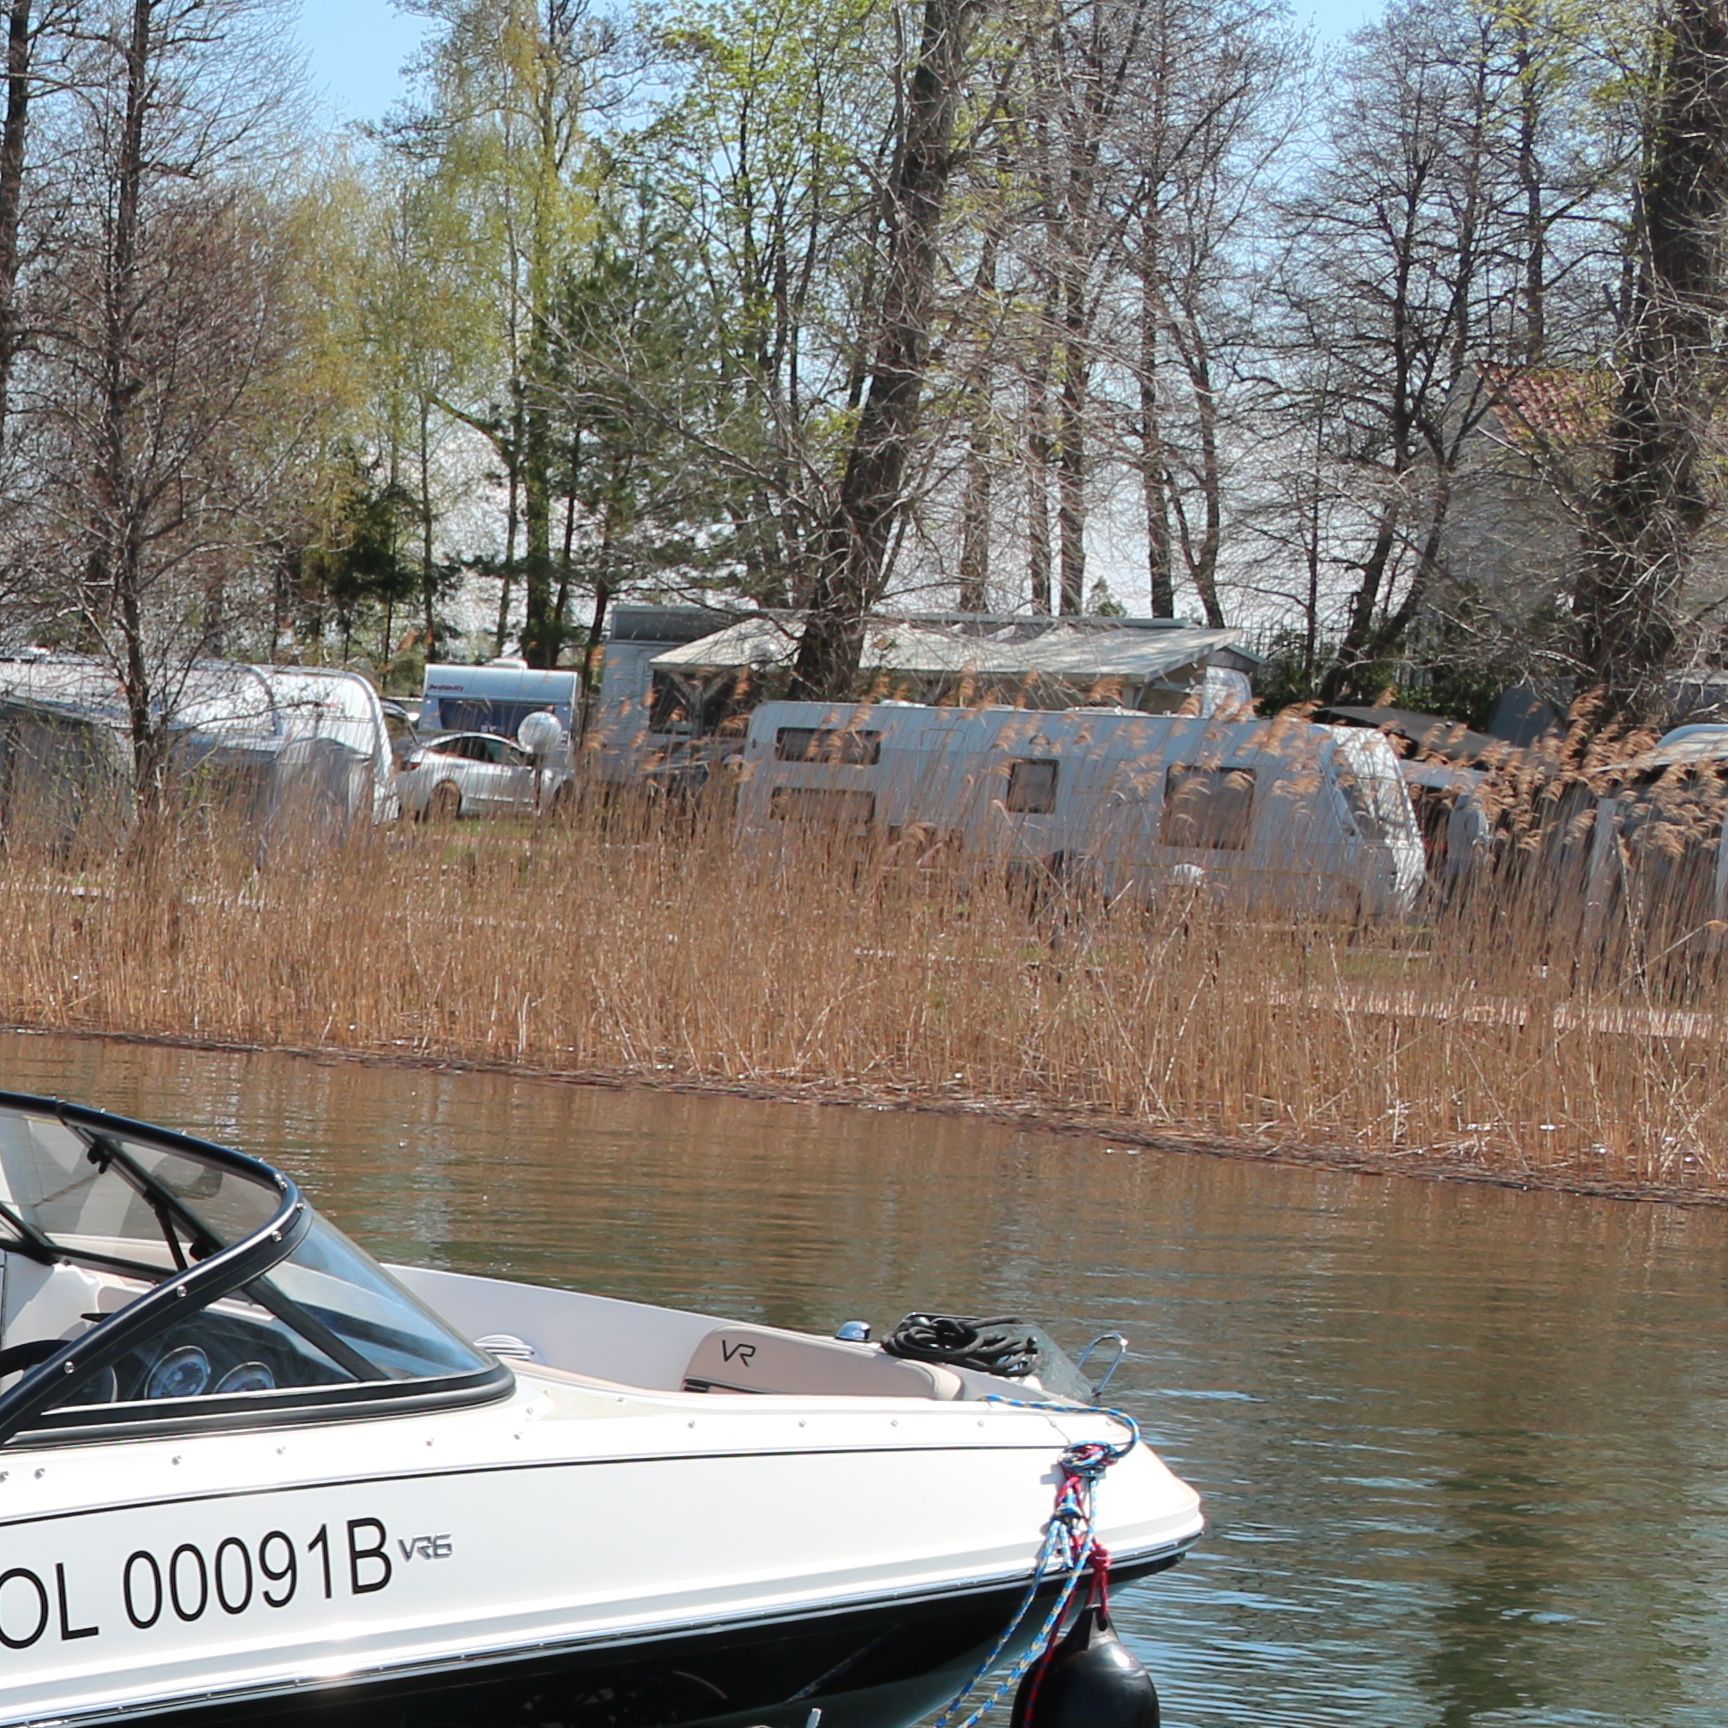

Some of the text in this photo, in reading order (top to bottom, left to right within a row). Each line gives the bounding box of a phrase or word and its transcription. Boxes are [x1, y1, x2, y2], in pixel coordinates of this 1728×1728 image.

[721, 1339, 756, 1367] VR
[397, 1533, 452, 1562] VR6
[123, 1516, 392, 1629] 00091B
